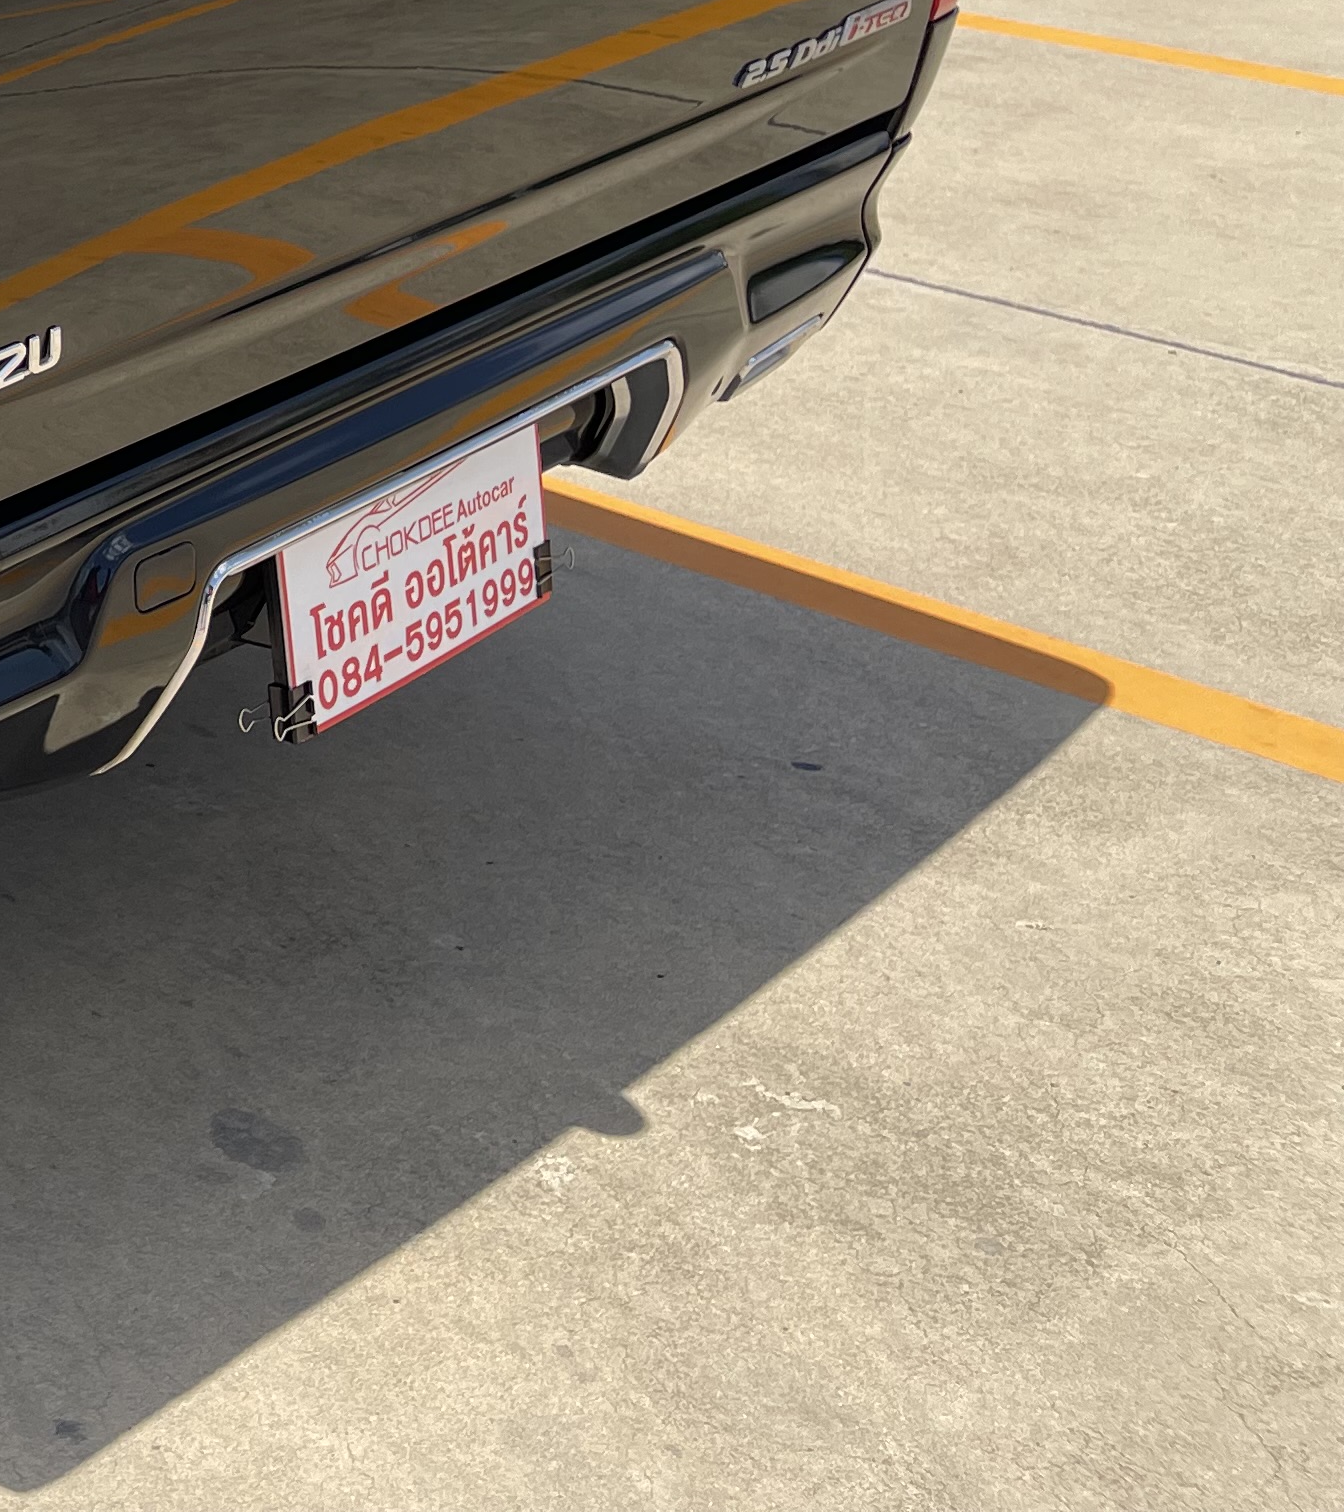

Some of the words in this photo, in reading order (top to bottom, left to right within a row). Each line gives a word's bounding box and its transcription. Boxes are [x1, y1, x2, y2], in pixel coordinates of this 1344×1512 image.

[309, 570, 394, 660] โชคดี
[404, 493, 530, 610] ออโต้คาร์
[360, 502, 456, 573] CHOKDEE
[456, 476, 516, 524] Autocar
[317, 557, 535, 711] 084-5951999
